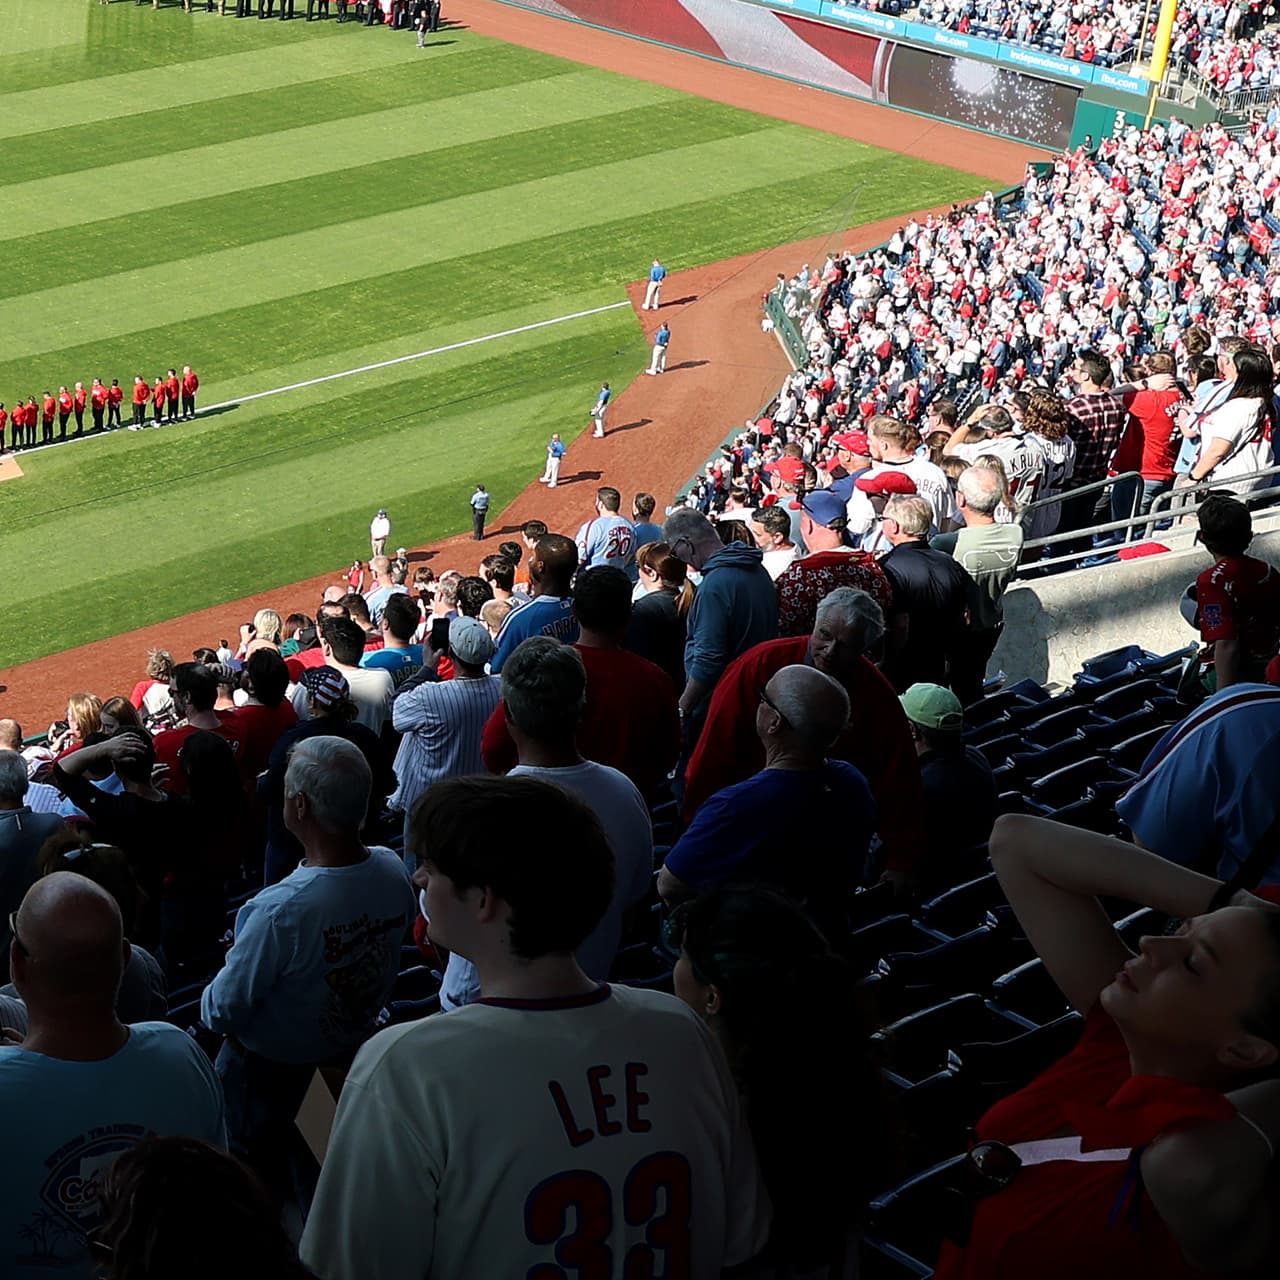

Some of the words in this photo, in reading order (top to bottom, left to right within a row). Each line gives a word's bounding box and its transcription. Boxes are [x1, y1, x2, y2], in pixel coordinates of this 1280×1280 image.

[934, 32, 968, 49] ibx.com
[1101, 73, 1138, 91] ibx.com
[606, 537, 631, 559] 20
[548, 1062, 652, 1148] LEE
